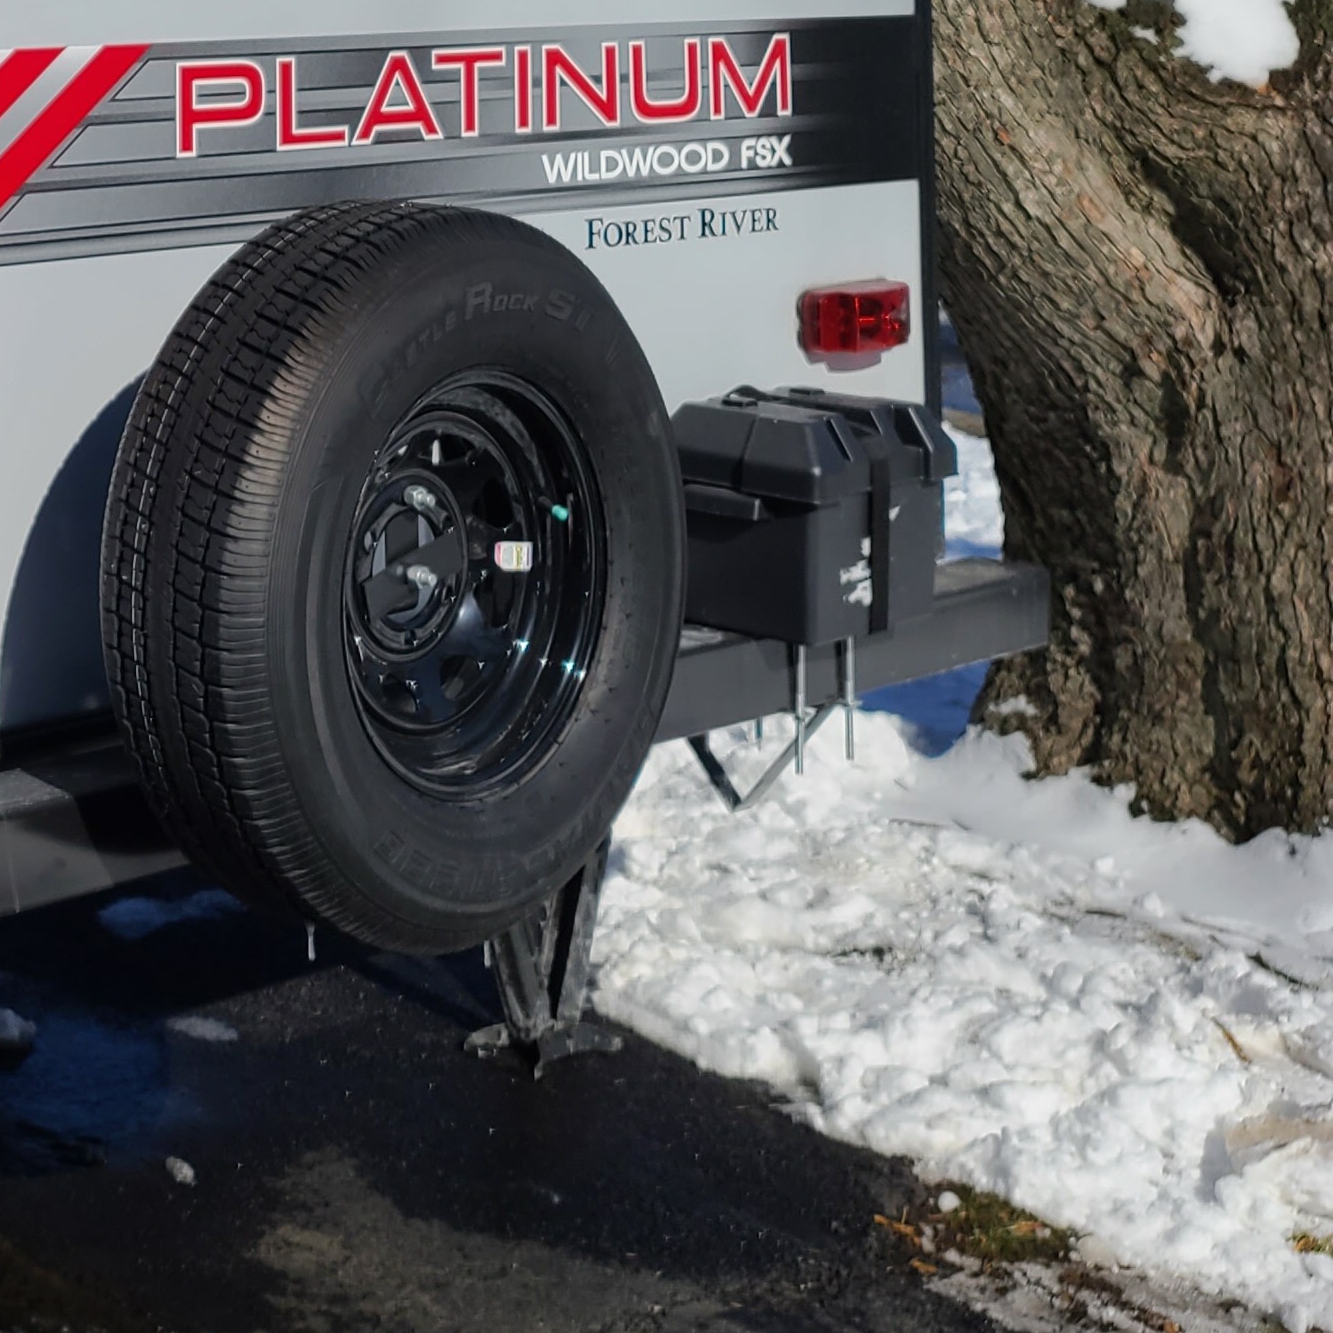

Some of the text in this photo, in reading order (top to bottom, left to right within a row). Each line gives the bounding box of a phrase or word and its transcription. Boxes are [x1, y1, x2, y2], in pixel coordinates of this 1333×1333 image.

[175, 32, 793, 158] PLATINUM
[541, 134, 794, 184] WILDWOOD FSX
[585, 207, 780, 251] FOREST RIVER
